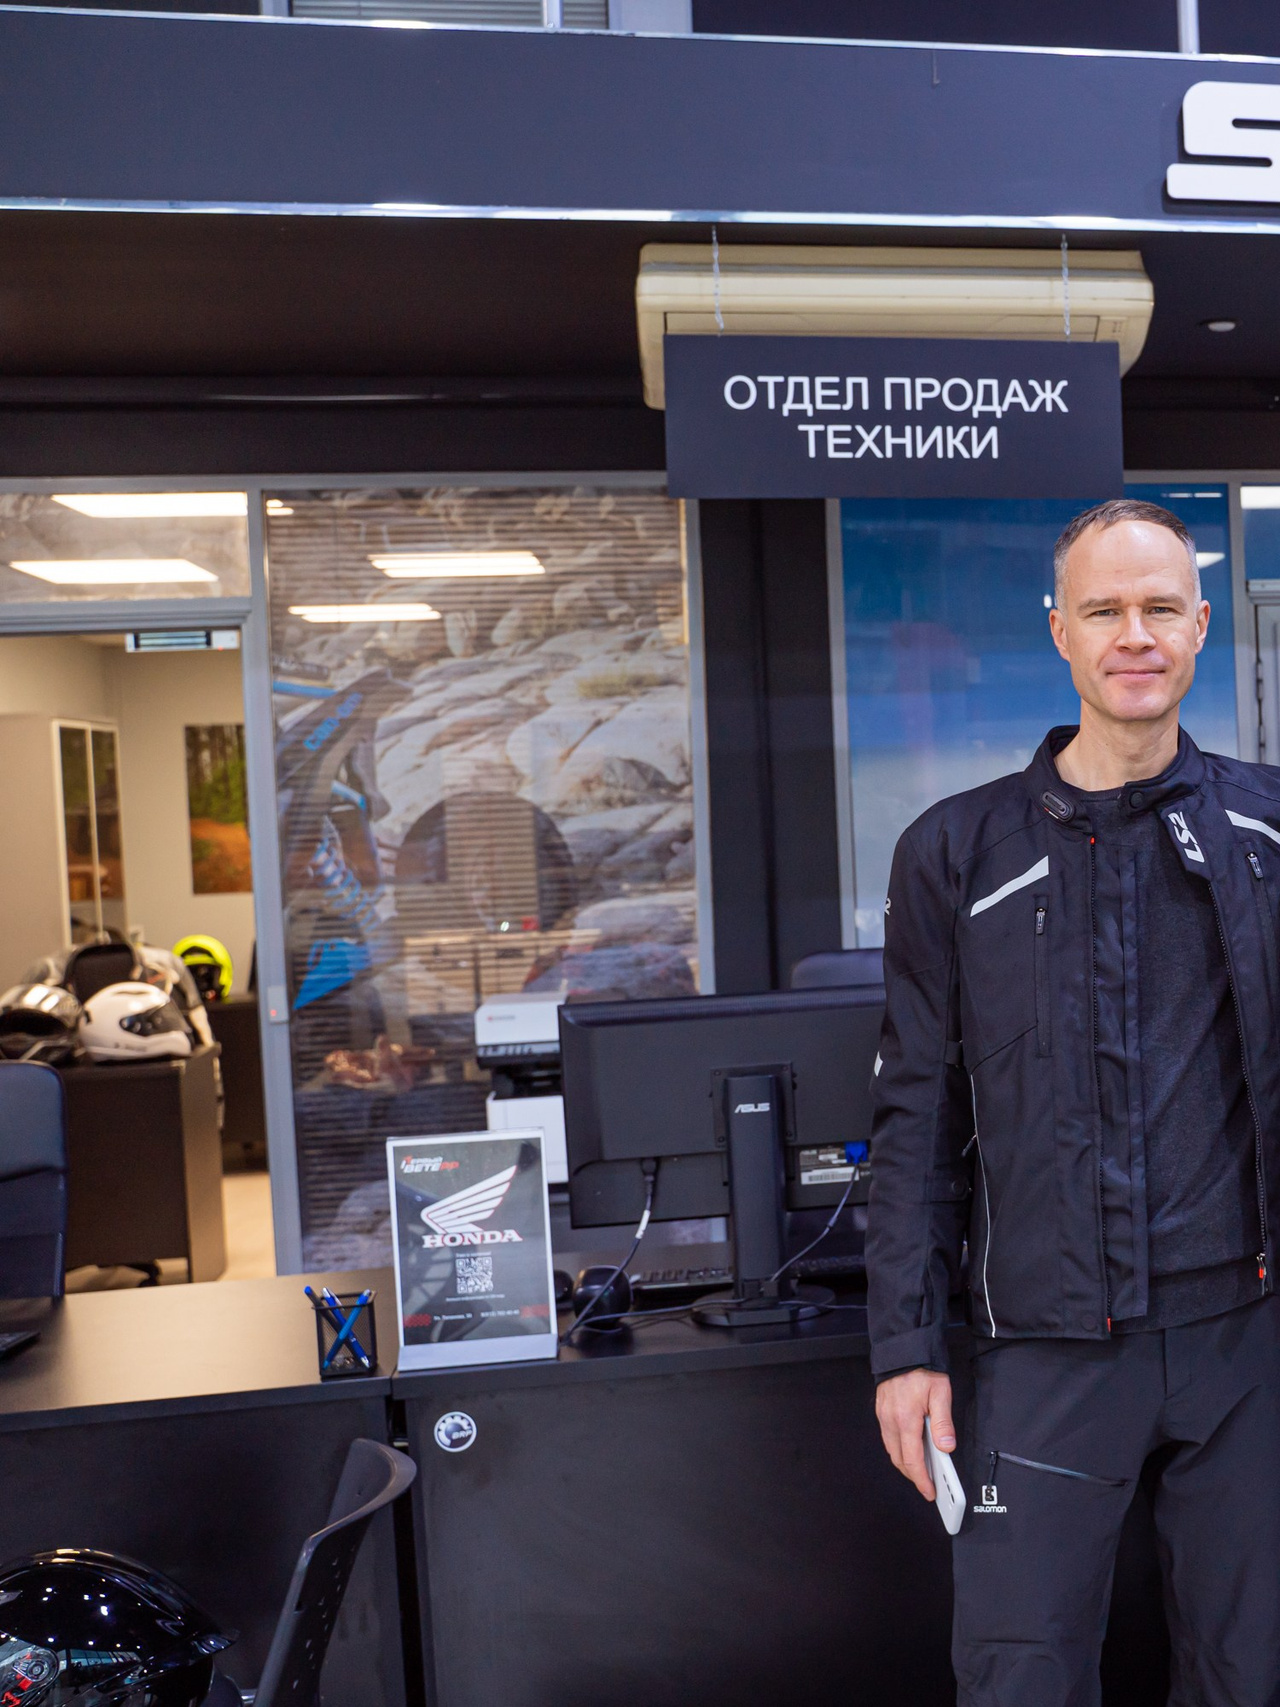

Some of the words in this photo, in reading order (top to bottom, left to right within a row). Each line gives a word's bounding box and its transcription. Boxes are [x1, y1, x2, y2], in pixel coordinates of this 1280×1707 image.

[724, 375, 869, 417] ОТДЕЛ
[884, 377, 1069, 418] ПРОДАЖ
[798, 424, 999, 459] ТЕХНИКИ
[1168, 811, 1205, 863] LS2
[734, 1102, 771, 1114] ASUS
[421, 1229, 523, 1249] HONDA
